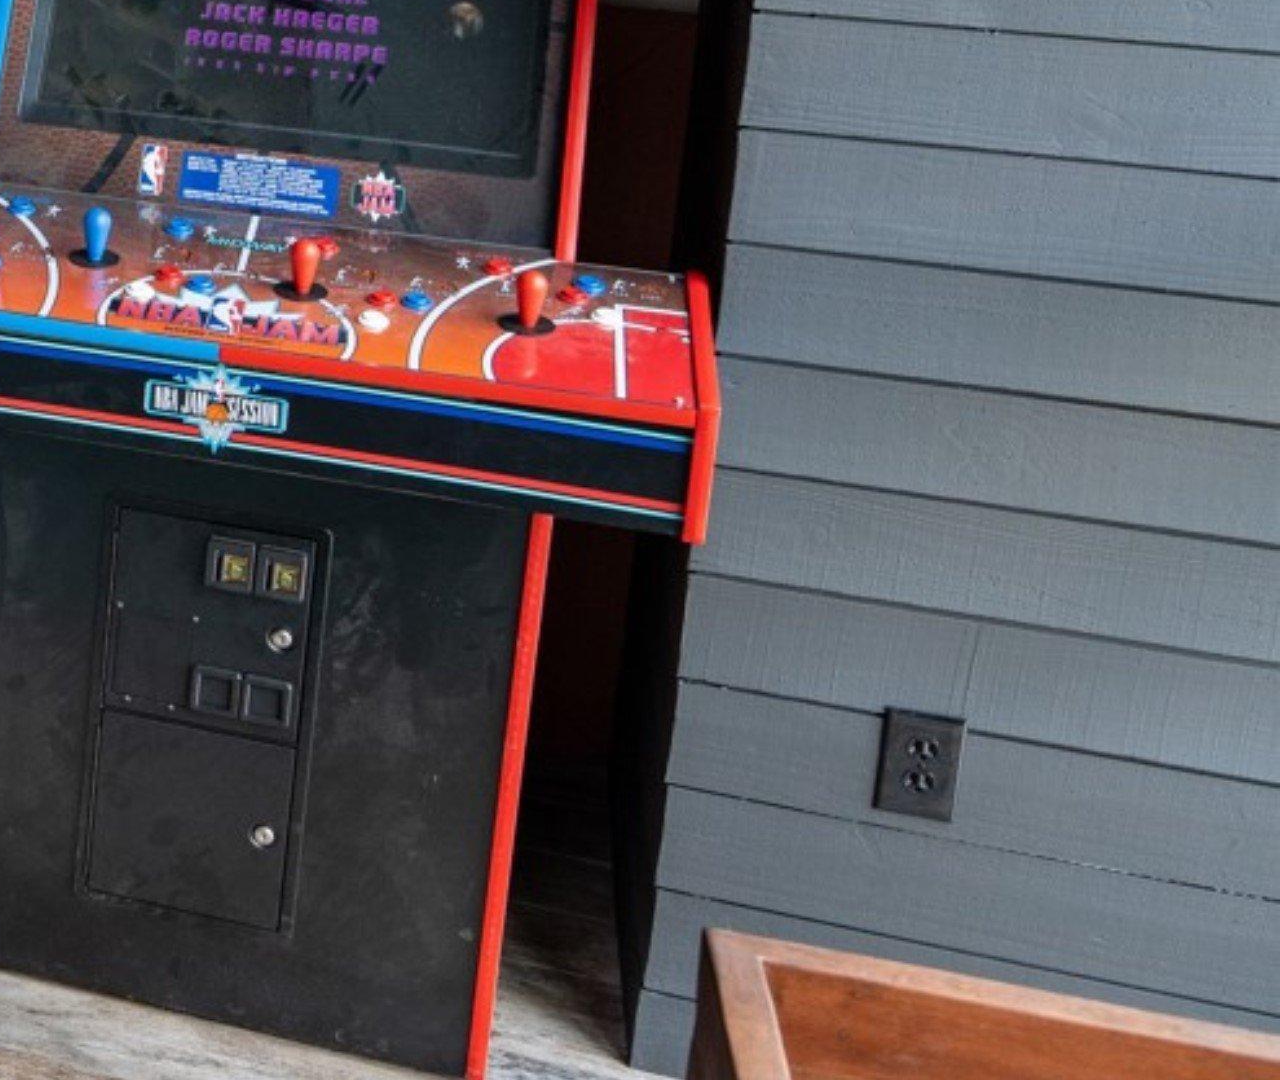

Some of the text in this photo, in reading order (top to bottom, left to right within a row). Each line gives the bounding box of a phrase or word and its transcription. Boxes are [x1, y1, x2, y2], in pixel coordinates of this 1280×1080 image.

[201, 1, 267, 25] JACK
[184, 28, 389, 65] ROGER SHARPE
[117, 297, 203, 324] NBA
[239, 316, 340, 345] JAM
